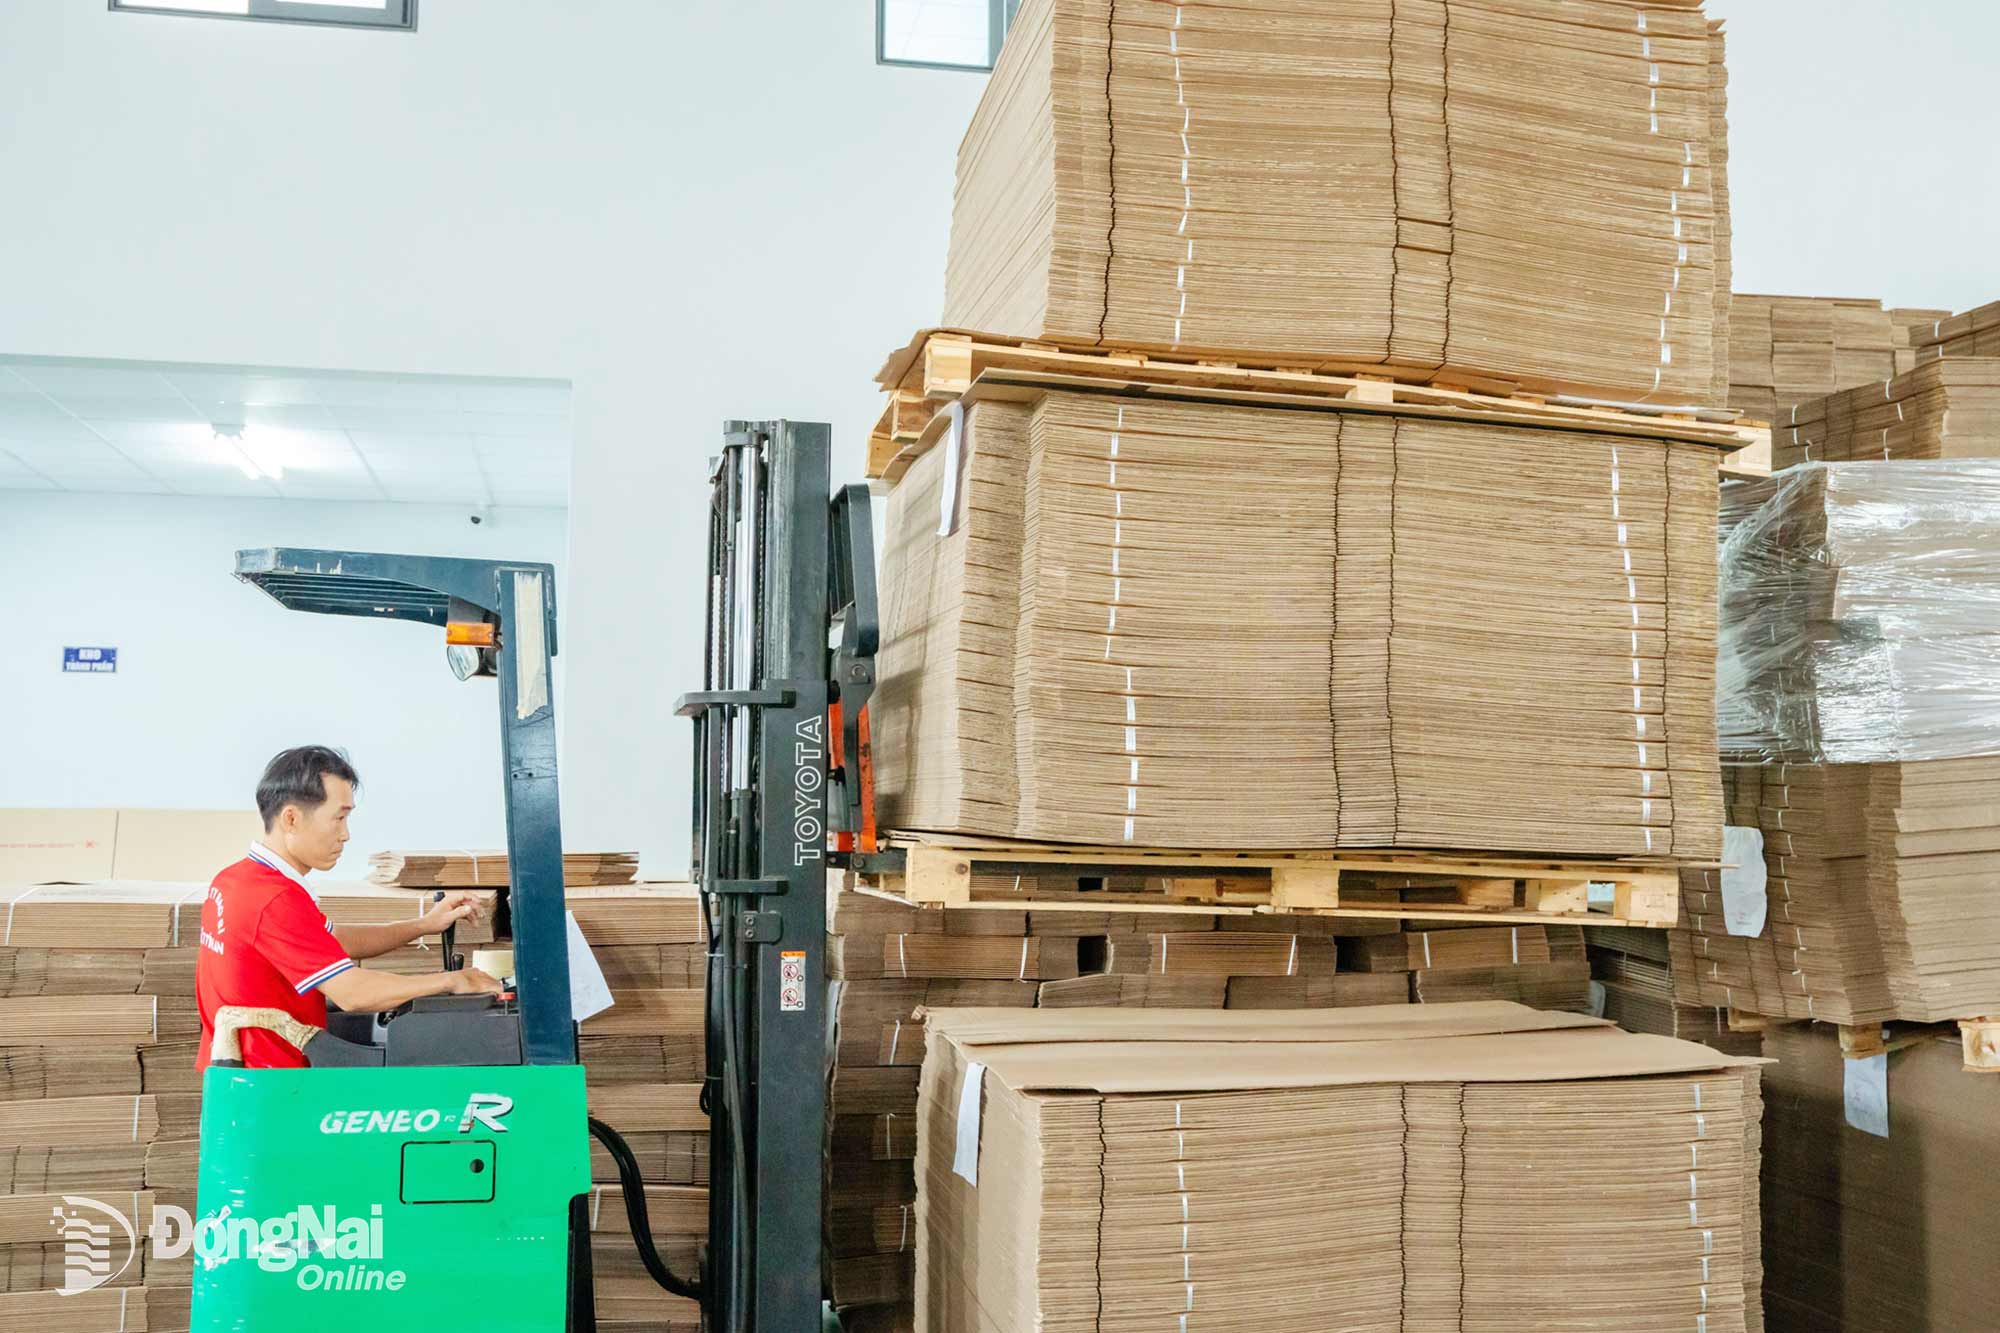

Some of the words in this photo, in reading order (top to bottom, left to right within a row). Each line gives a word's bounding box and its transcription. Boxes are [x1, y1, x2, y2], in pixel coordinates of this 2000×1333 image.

[794, 714, 822, 866] TOYOTA
[319, 1108, 440, 1134] GENEO
[458, 1092, 514, 1134] R
